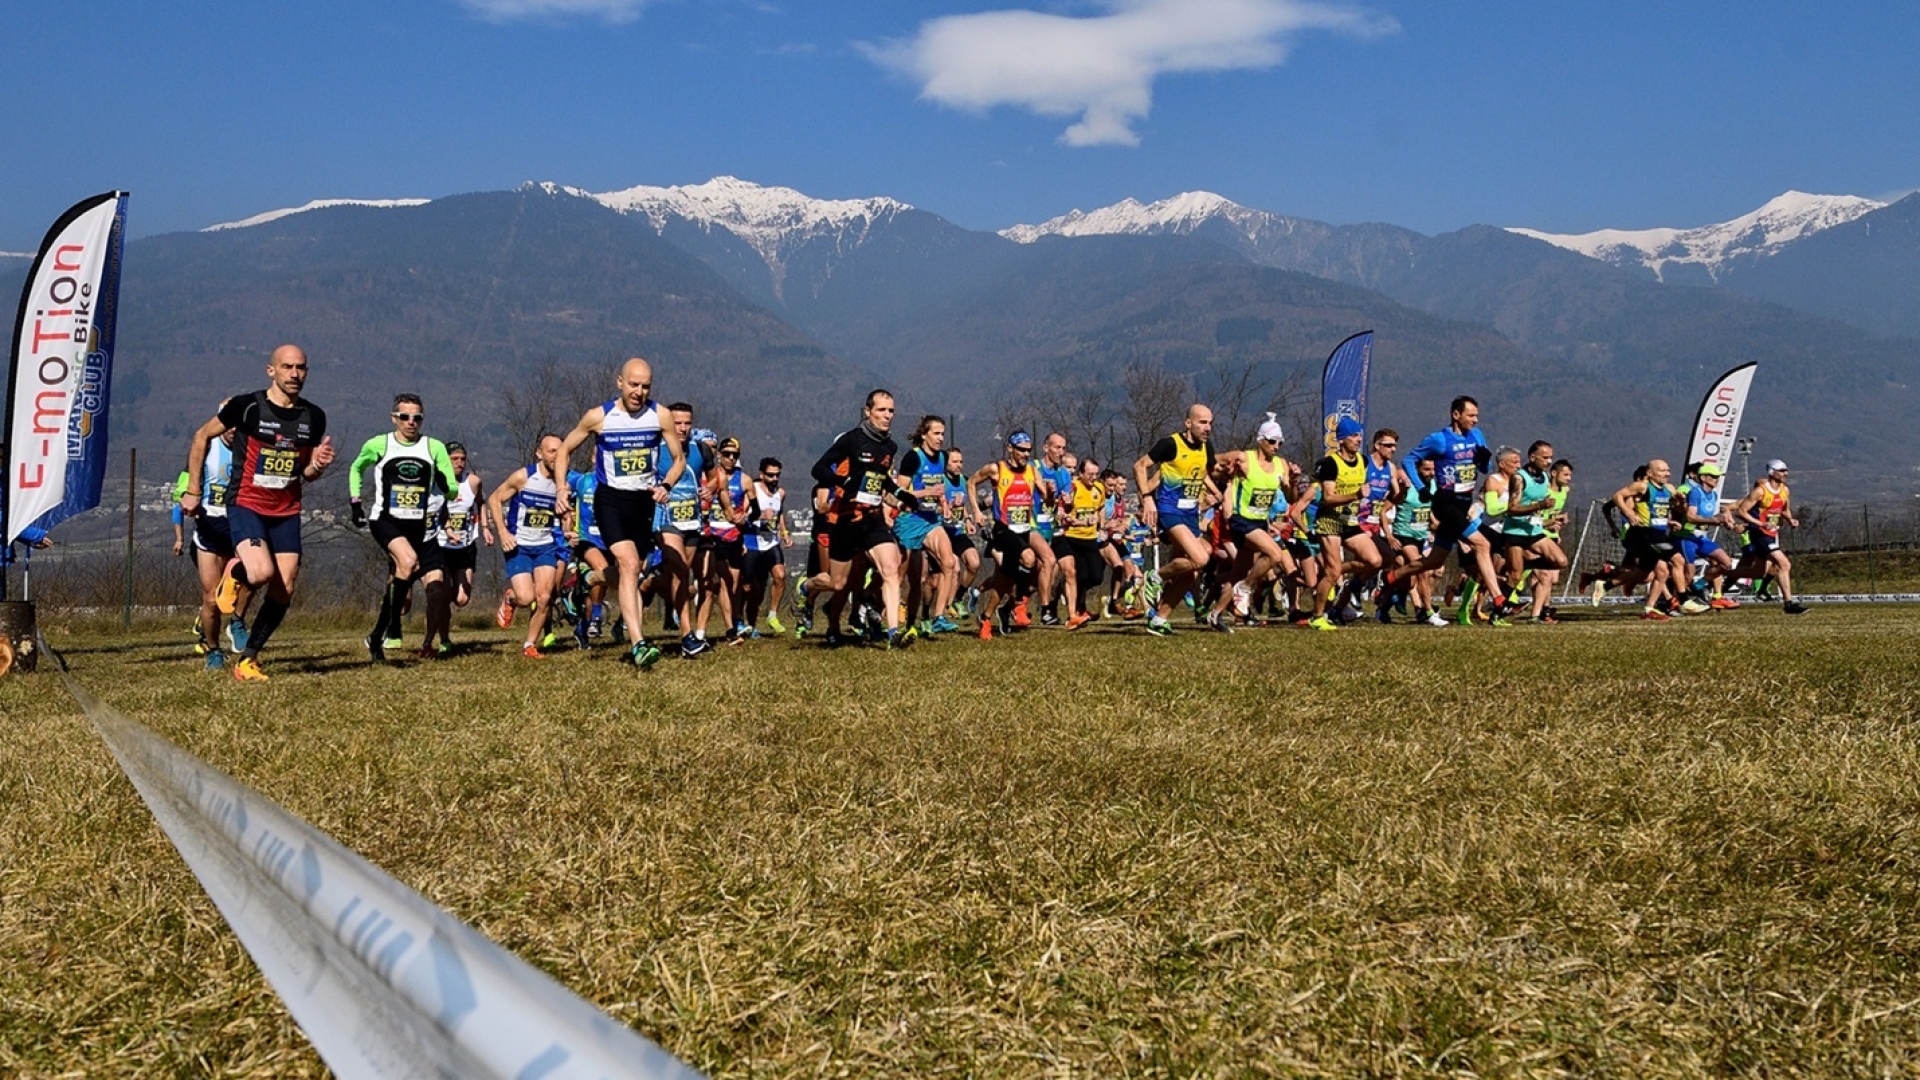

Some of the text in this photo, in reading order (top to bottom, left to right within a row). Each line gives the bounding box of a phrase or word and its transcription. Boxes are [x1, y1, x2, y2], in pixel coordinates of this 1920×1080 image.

[74, 282, 92, 343] Bike
[83, 352, 105, 412] CLUB
[263, 457, 295, 472] 509
[621, 456, 647, 472] 576
[396, 492, 420, 504] 553
[529, 514, 550, 524] 578
[673, 506, 694, 519] 558
[450, 518, 464, 529] 02
